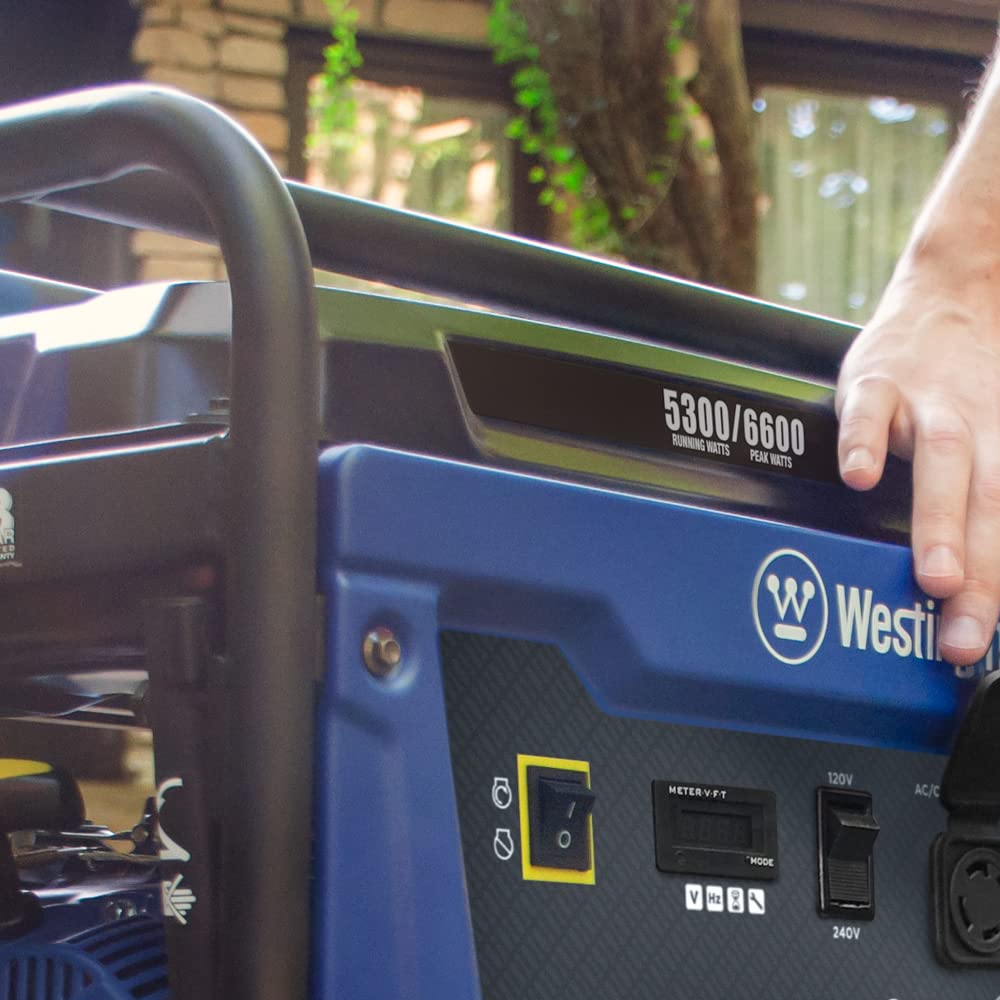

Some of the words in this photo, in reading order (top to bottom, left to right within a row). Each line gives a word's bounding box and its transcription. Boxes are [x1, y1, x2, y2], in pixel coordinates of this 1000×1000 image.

[663, 388, 805, 456] 5300/6600
[672, 433, 705, 451] RUNNING
[706, 439, 730, 457] WATTS
[750, 449, 769, 465] PEAK
[770, 453, 793, 469] WATTS
[827, 772, 853, 785] 120V
[914, 783, 940, 798] AC/C
[750, 856, 774, 867] MODE
[690, 890, 698, 903] V
[709, 892, 721, 905] Hz
[832, 926, 860, 940] 240V
